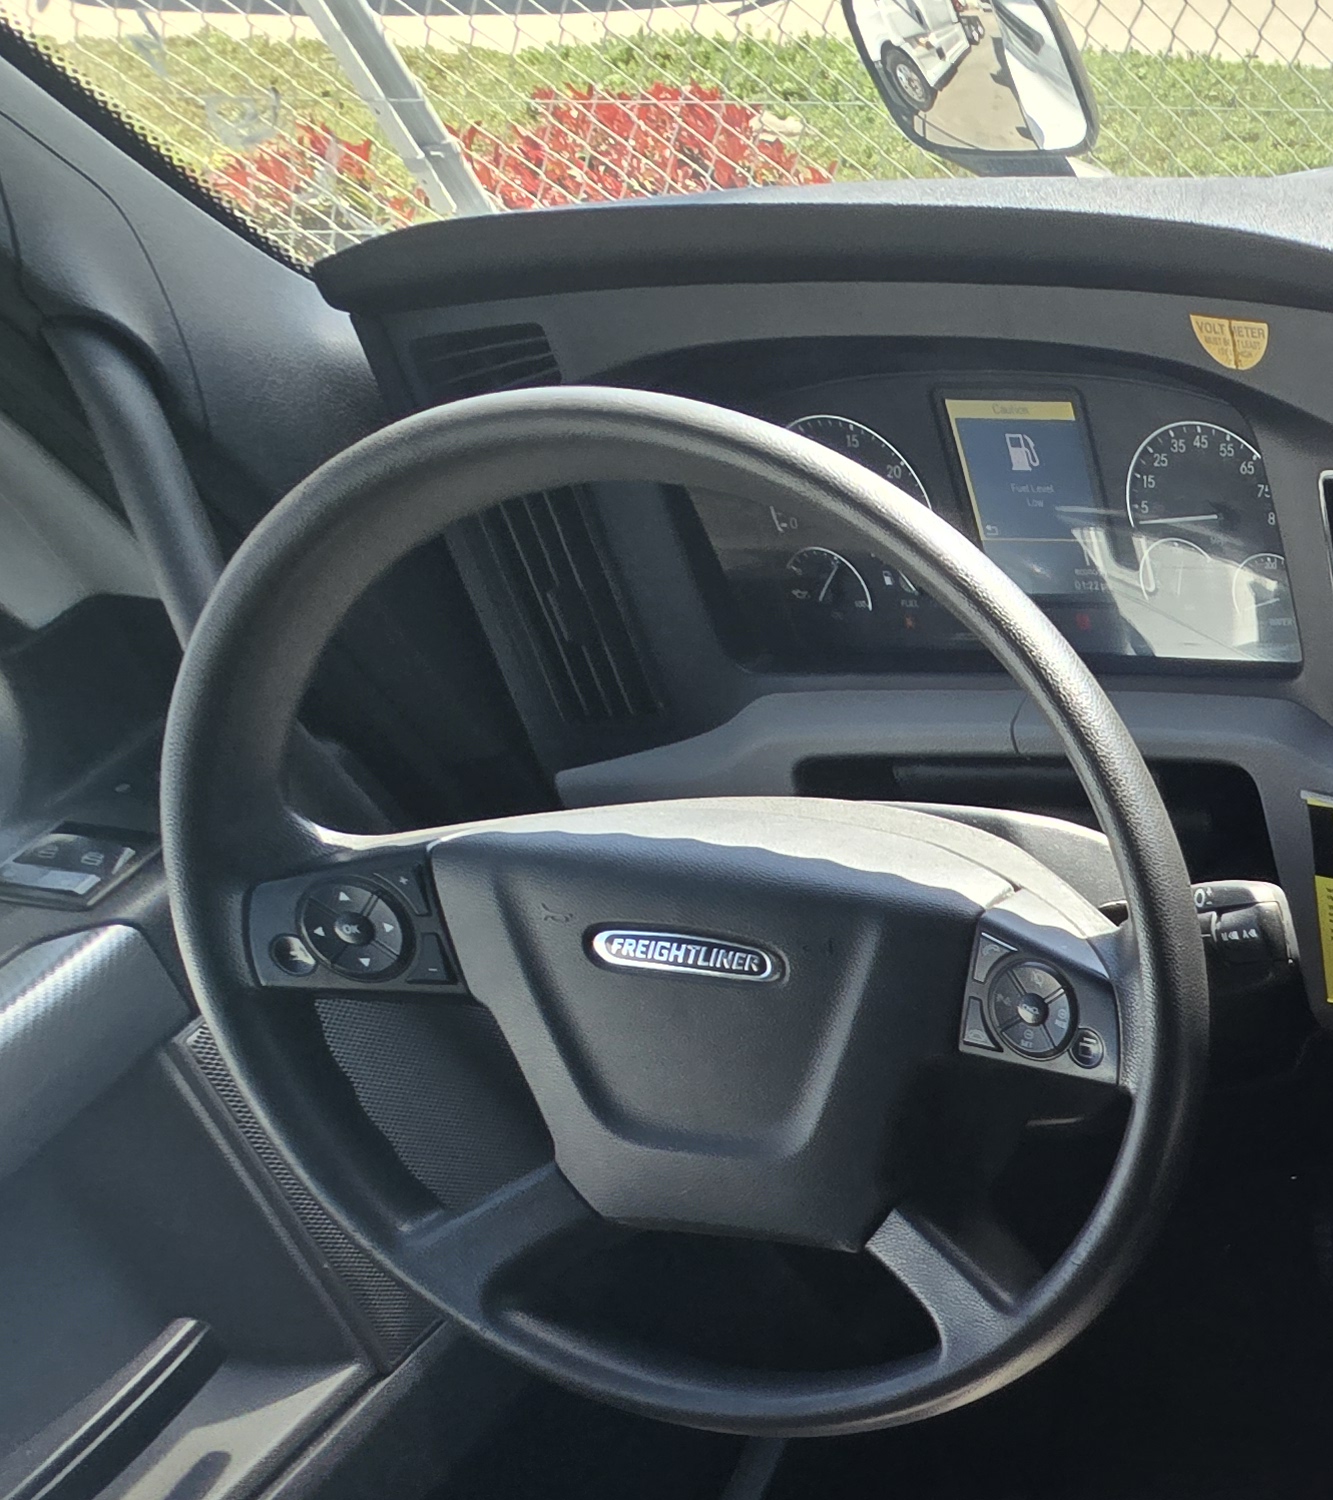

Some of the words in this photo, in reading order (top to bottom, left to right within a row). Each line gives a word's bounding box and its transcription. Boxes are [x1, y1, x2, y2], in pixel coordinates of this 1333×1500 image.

[1195, 320, 1225, 335] VOLT
[992, 403, 1029, 415] Caution
[847, 435, 859, 448] 15
[1171, 439, 1186, 453] 35
[1193, 435, 1208, 449] 45
[1219, 443, 1235, 457] 55
[1153, 453, 1168, 467] 25
[886, 465, 901, 479] 20
[1240, 461, 1255, 475] 65
[1010, 482, 1029, 493] Fuel
[1031, 483, 1055, 494] Level
[1142, 475, 1156, 488] 15
[1026, 498, 1044, 508] Low
[1140, 501, 1149, 514] 5
[342, 923, 361, 935] OK
[610, 937, 760, 973] FREIGHTLINER
